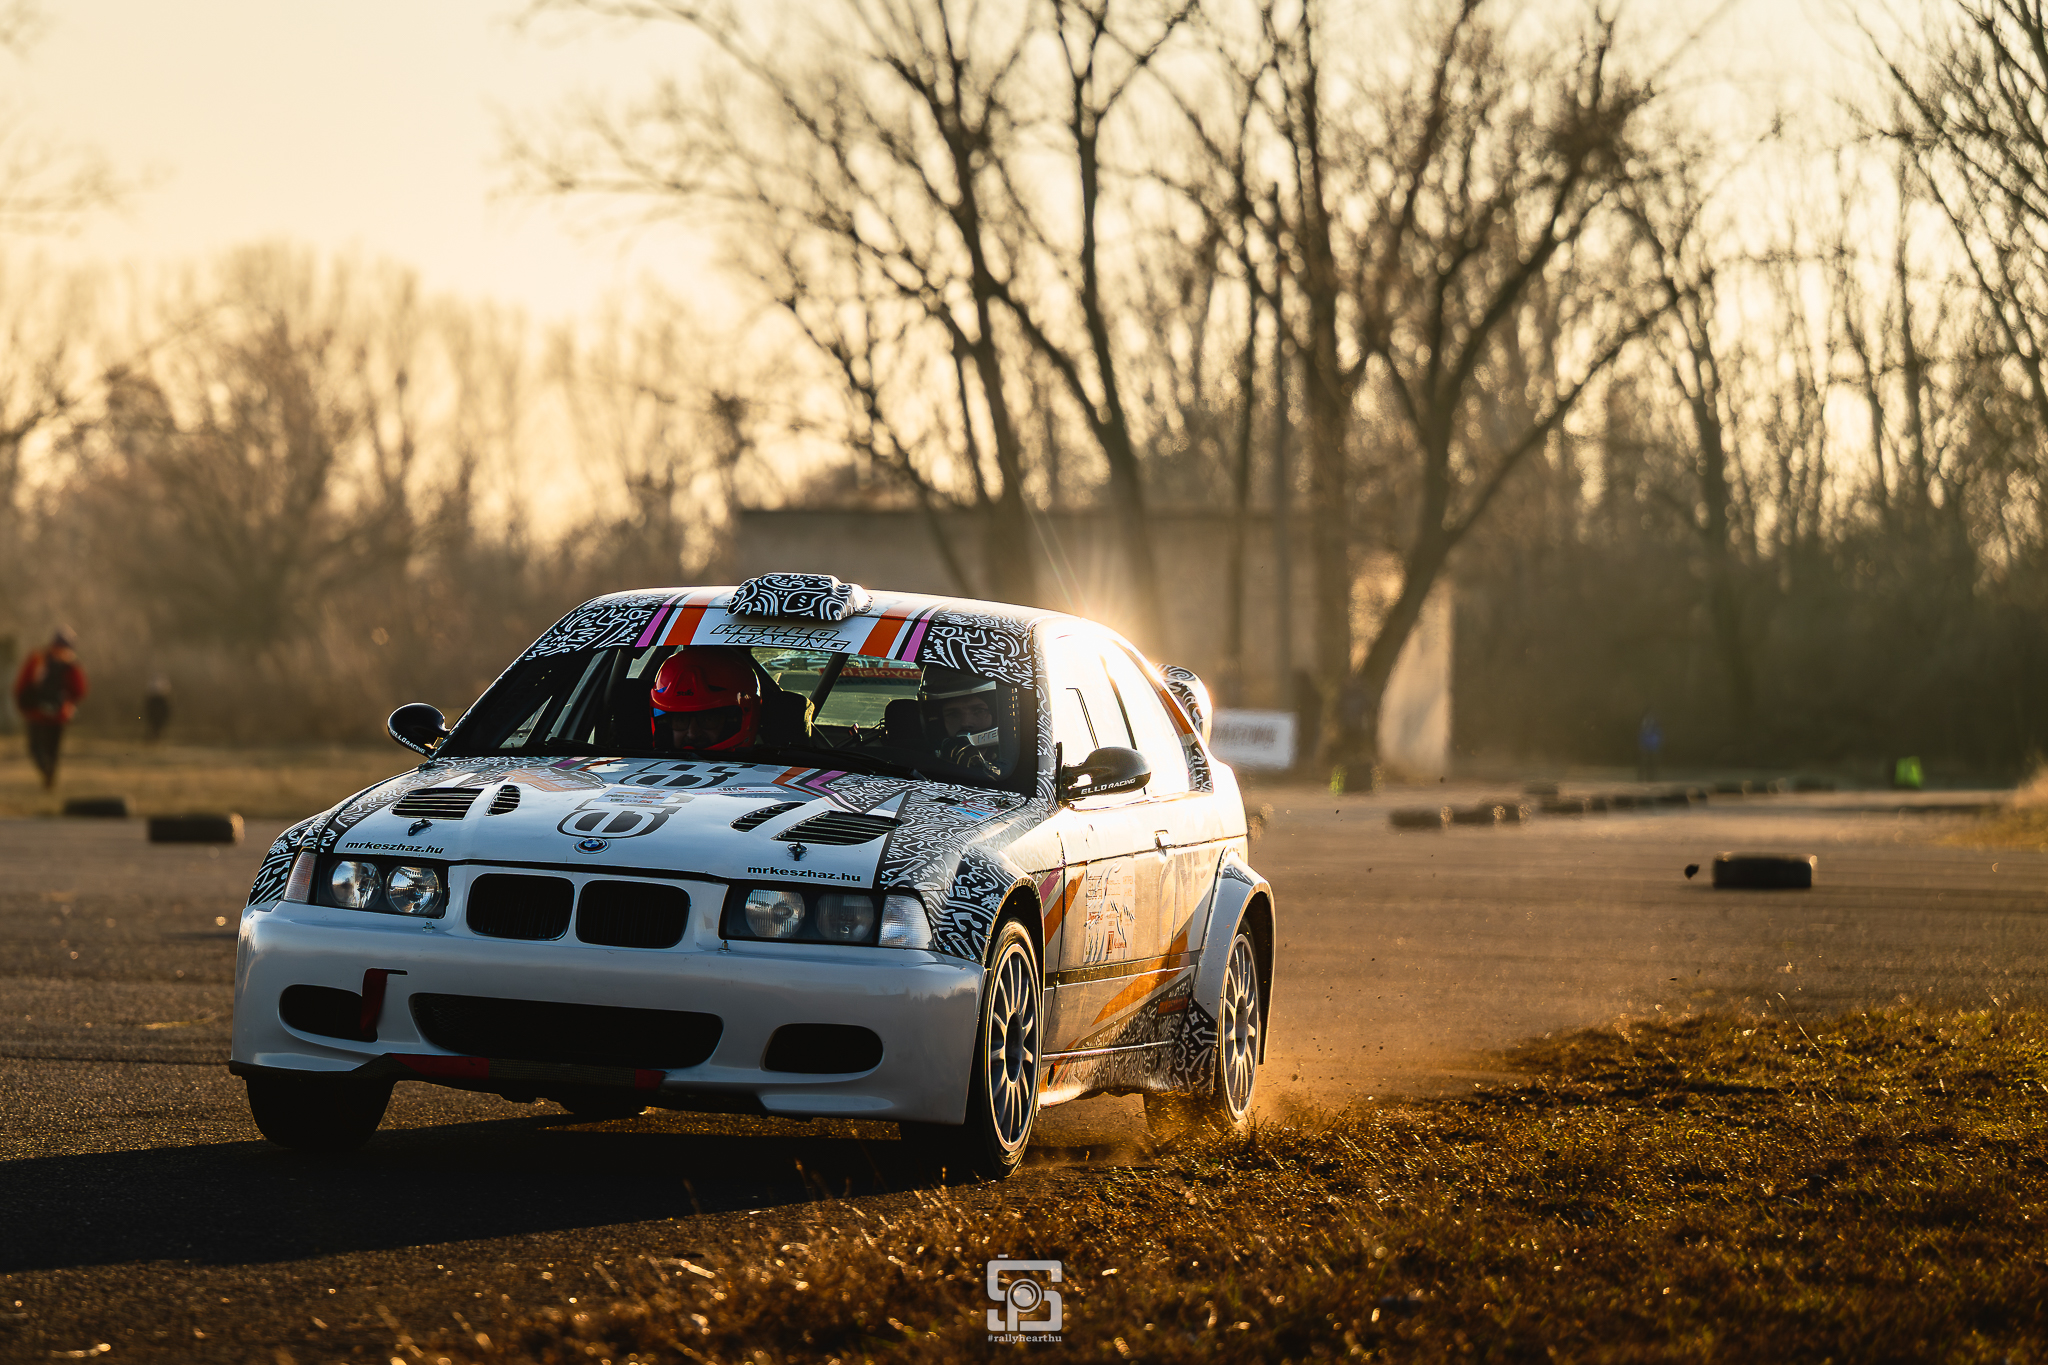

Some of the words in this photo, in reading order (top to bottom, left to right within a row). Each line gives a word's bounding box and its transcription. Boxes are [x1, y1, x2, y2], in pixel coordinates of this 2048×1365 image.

[710, 624, 840, 640] HELLO
[724, 633, 852, 652] RACING
[1108, 777, 1136, 789] RACING
[345, 841, 445, 855] mrkeszhaz.hu
[747, 866, 861, 882] mrkeszhaz.hu
